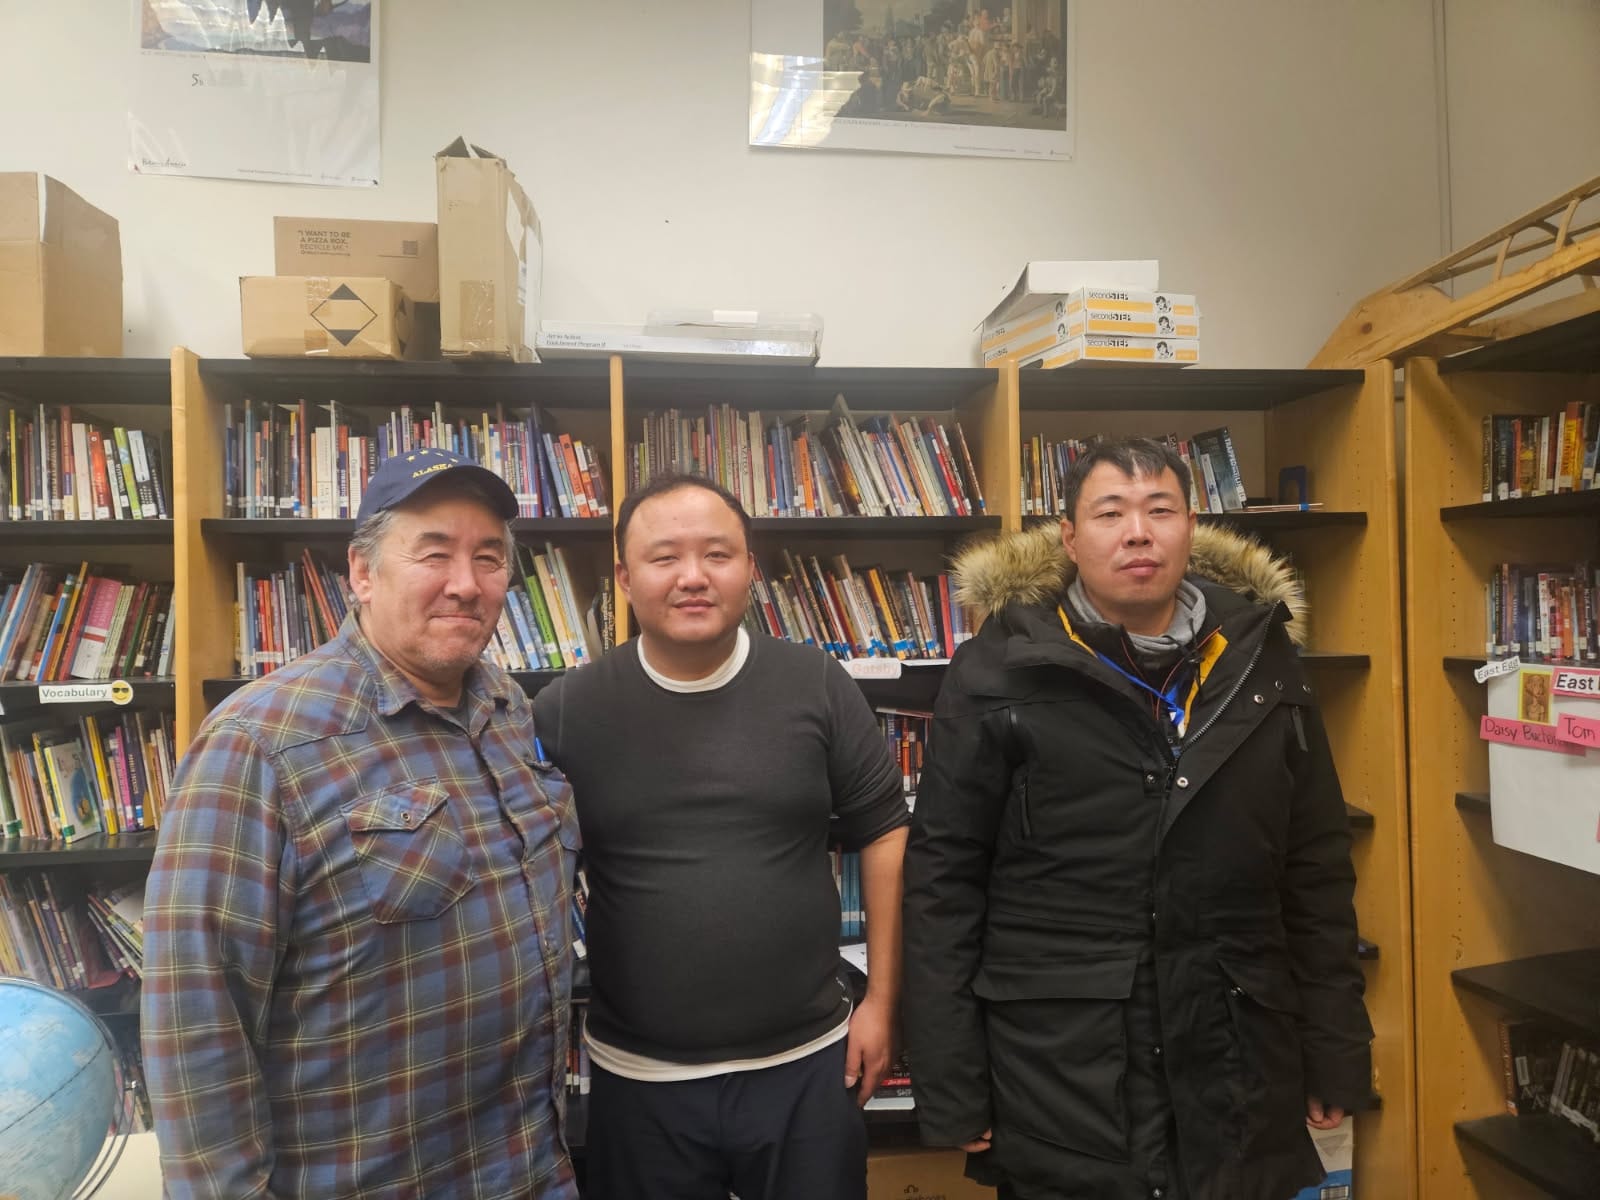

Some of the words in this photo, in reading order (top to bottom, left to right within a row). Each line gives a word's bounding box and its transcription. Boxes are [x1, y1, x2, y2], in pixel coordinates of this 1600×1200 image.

[1477, 666, 1499, 680] East
[1502, 659, 1519, 672] Egg
[42, 687, 107, 698] Vocabulary
[1556, 674, 1594, 690] East
[1485, 718, 1518, 741] Daisy
[1563, 717, 1596, 741] Tom
